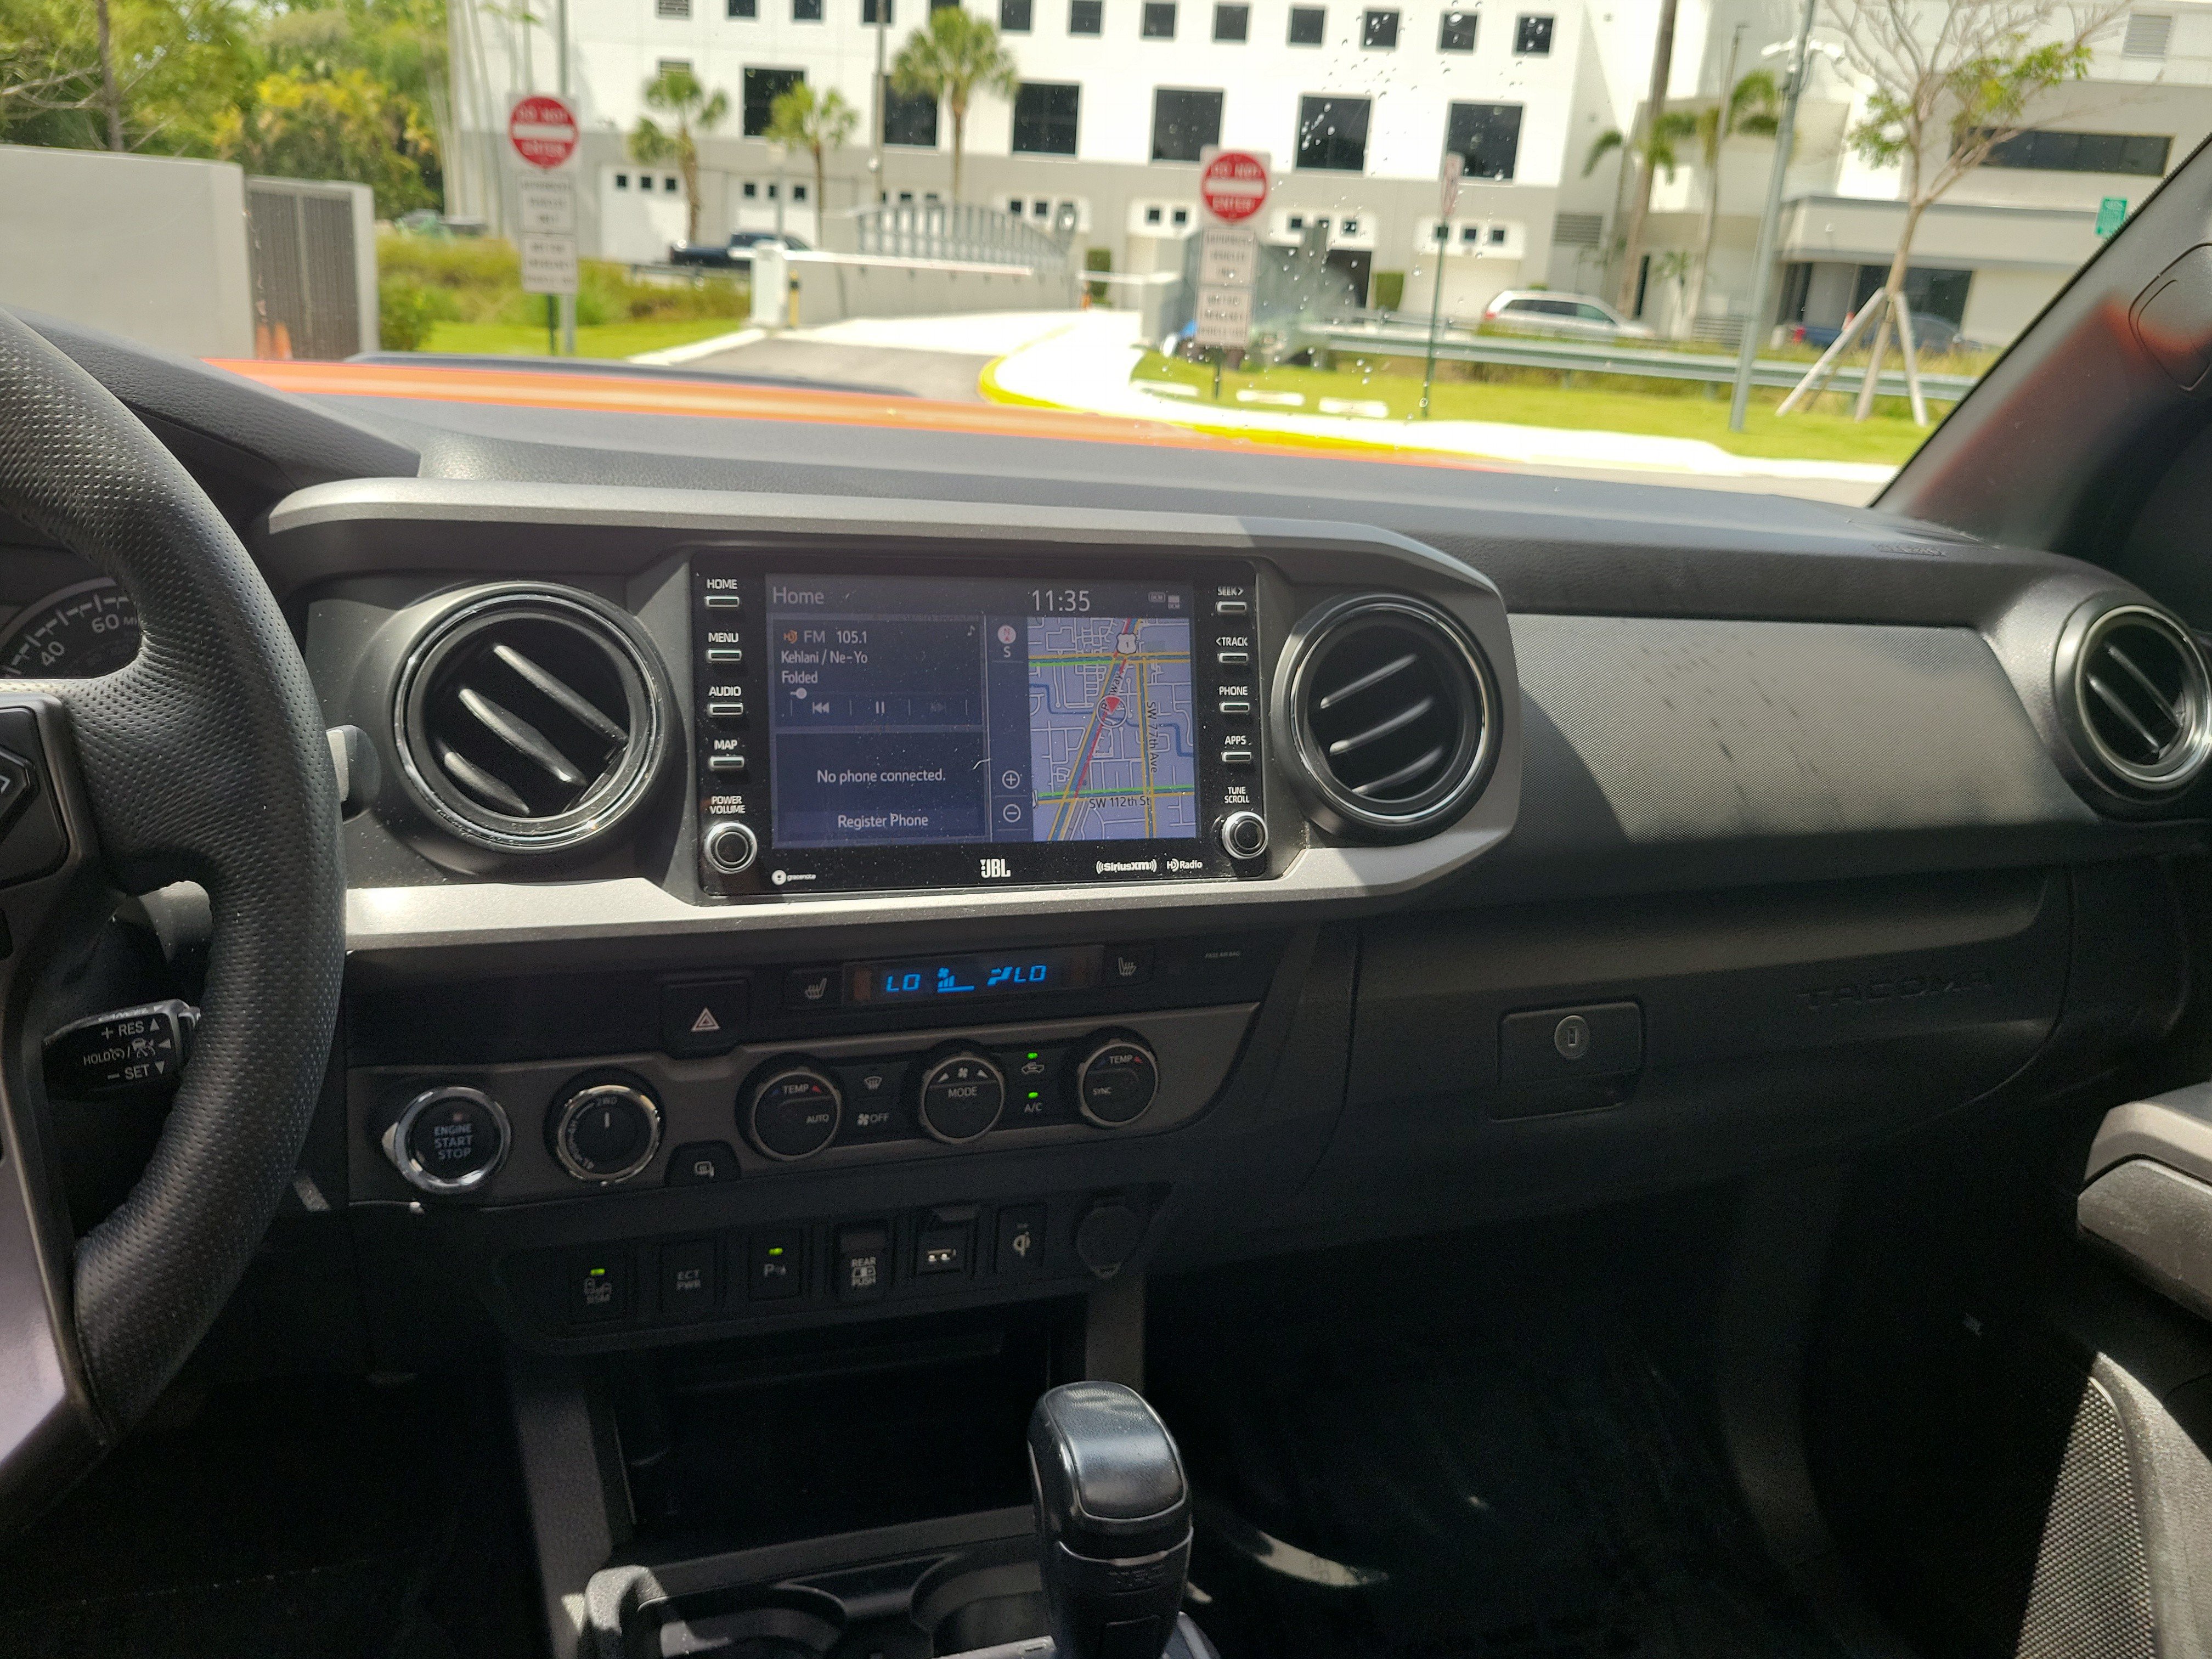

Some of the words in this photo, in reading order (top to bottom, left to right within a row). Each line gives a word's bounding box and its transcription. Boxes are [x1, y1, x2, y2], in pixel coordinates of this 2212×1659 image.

[707, 579, 737, 590] HOME
[772, 587, 824, 604] Home
[1032, 590, 1091, 612] 11:35
[91, 613, 120, 634] 60
[708, 633, 738, 643] MENU
[804, 631, 826, 644] FM
[837, 631, 867, 644] 105.1
[41, 640, 65, 667] 40
[781, 650, 819, 664] Kehlani
[830, 650, 868, 664] Ne-Yo
[1003, 646, 1011, 658] S
[781, 670, 819, 684] Folded
[708, 686, 741, 697] AUDIO
[1218, 686, 1248, 696] PHONE
[1147, 701, 1157, 720] SW
[1148, 725, 1159, 748] 77th
[1224, 735, 1246, 746] APPS
[714, 739, 738, 751] MAP
[1150, 752, 1160, 773] Ave
[817, 769, 837, 783] No
[839, 769, 877, 786] phone
[880, 769, 946, 783] connected.
[1227, 786, 1246, 795] TUNE
[712, 795, 742, 805] POWER
[1090, 797, 1107, 809] SW
[1110, 797, 1137, 808] 112th
[1139, 796, 1151, 806] St
[1223, 794, 1250, 804] SCROLL
[709, 804, 746, 815] VOLUME
[838, 814, 887, 831] Register
[890, 812, 929, 827] Phone
[981, 859, 1011, 878] JBL
[1180, 860, 1203, 870] Radio
[119, 1020, 144, 1037] RES
[83, 1050, 110, 1066] HOLD
[1109, 1054, 1133, 1064] TEMP
[125, 1064, 150, 1080] SET
[782, 1084, 809, 1094] TEMP
[947, 1086, 978, 1098] MODE
[1092, 1087, 1111, 1096] SYNC
[1024, 1103, 1042, 1113] A/C
[806, 1114, 830, 1124] AUTO
[871, 1113, 890, 1124] OFF
[434, 1124, 472, 1137] ENGINE
[434, 1135, 472, 1149] START
[438, 1147, 472, 1161] STOP
[851, 1257, 877, 1267] REAR
